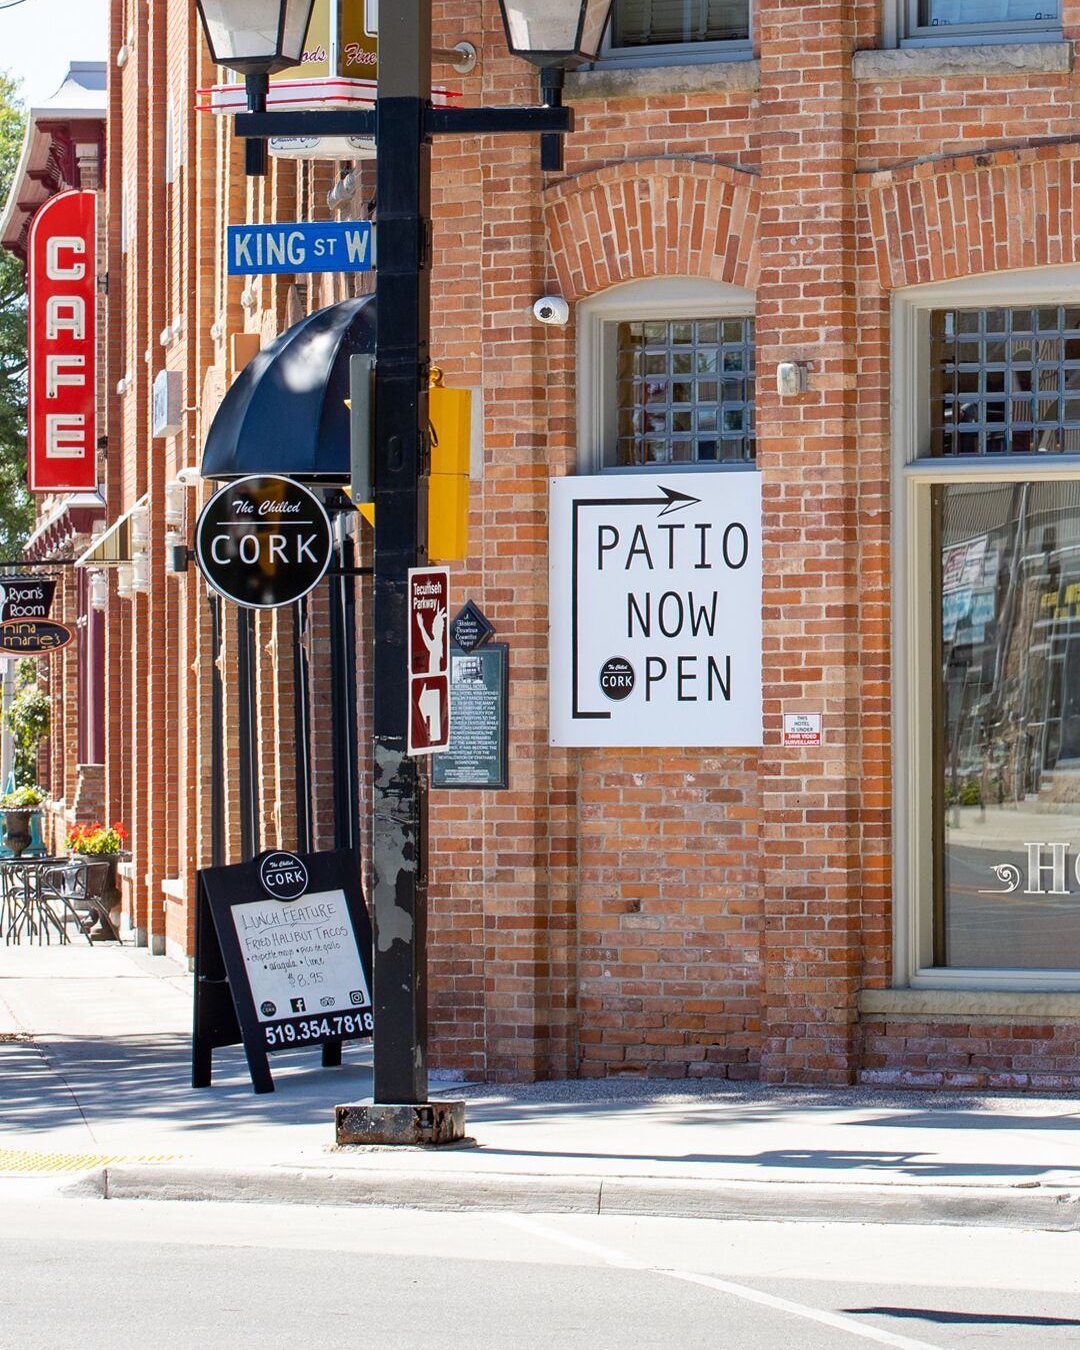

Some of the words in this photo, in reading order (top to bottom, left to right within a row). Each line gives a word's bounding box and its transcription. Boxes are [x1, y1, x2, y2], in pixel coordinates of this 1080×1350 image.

[344, 42, 377, 67] Fine
[235, 231, 306, 266] KING
[313, 238, 337, 256] ST
[345, 230, 369, 263] W
[46, 236, 85, 459] CAFE
[232, 500, 254, 514] The
[258, 500, 302, 515] Chilled
[211, 534, 318, 565] CORK
[598, 522, 749, 570] PATIO
[9, 587, 44, 603] Ryan's
[413, 581, 442, 595] Tecumseh
[10, 604, 45, 617] Room
[413, 596, 437, 612] Parkway
[627, 591, 718, 638] NOW
[4, 623, 36, 634] nina
[4, 633, 61, 646] marie's
[602, 675, 632, 687] CORK
[265, 870, 305, 887] CORK
[241, 911, 281, 930] LUNCH
[283, 903, 337, 923] FEATURE
[245, 937, 272, 951] FRIED
[272, 931, 313, 947] HALIBUT
[313, 926, 349, 942] TACOS
[287, 971, 324, 988] $8.95
[265, 1012, 374, 1044] 519.354.7818
